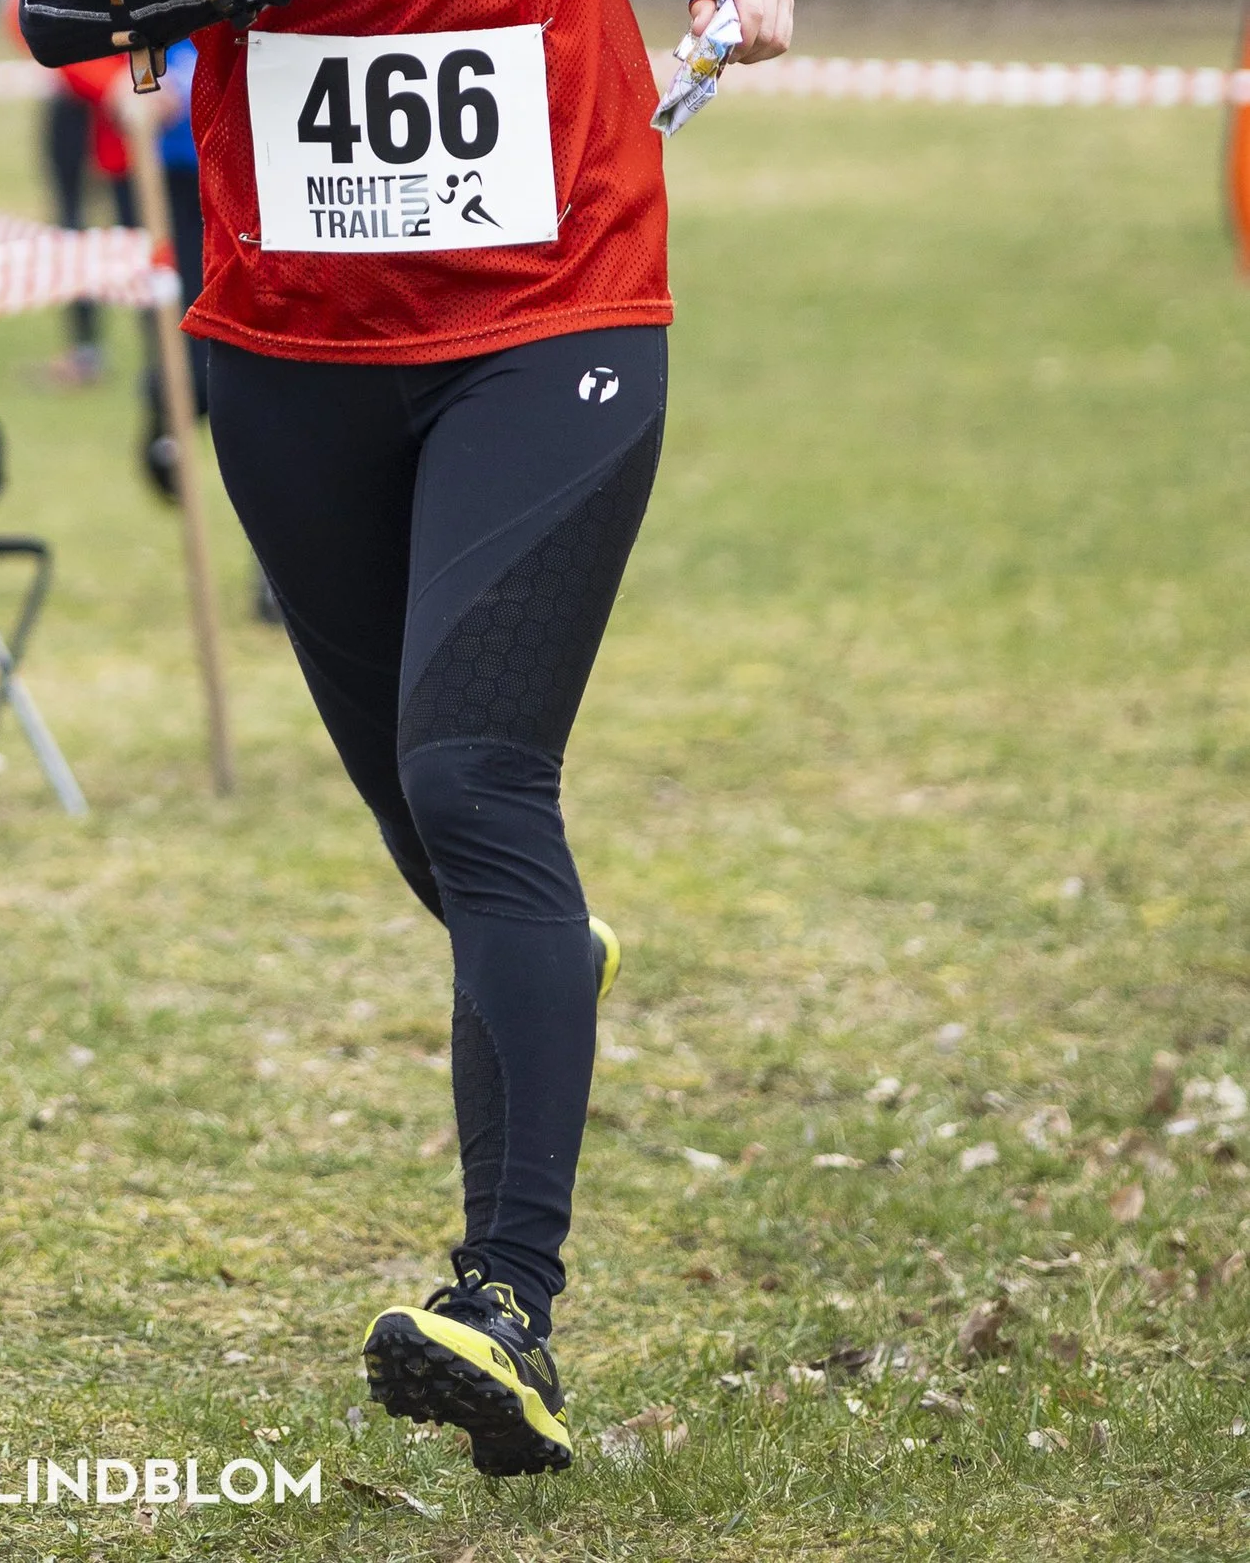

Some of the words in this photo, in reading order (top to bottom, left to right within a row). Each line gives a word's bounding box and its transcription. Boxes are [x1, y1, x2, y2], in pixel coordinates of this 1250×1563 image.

[297, 48, 499, 165] 466
[307, 175, 396, 206] NIGHT
[399, 173, 431, 238] RUN
[309, 209, 399, 239] TRAIL
